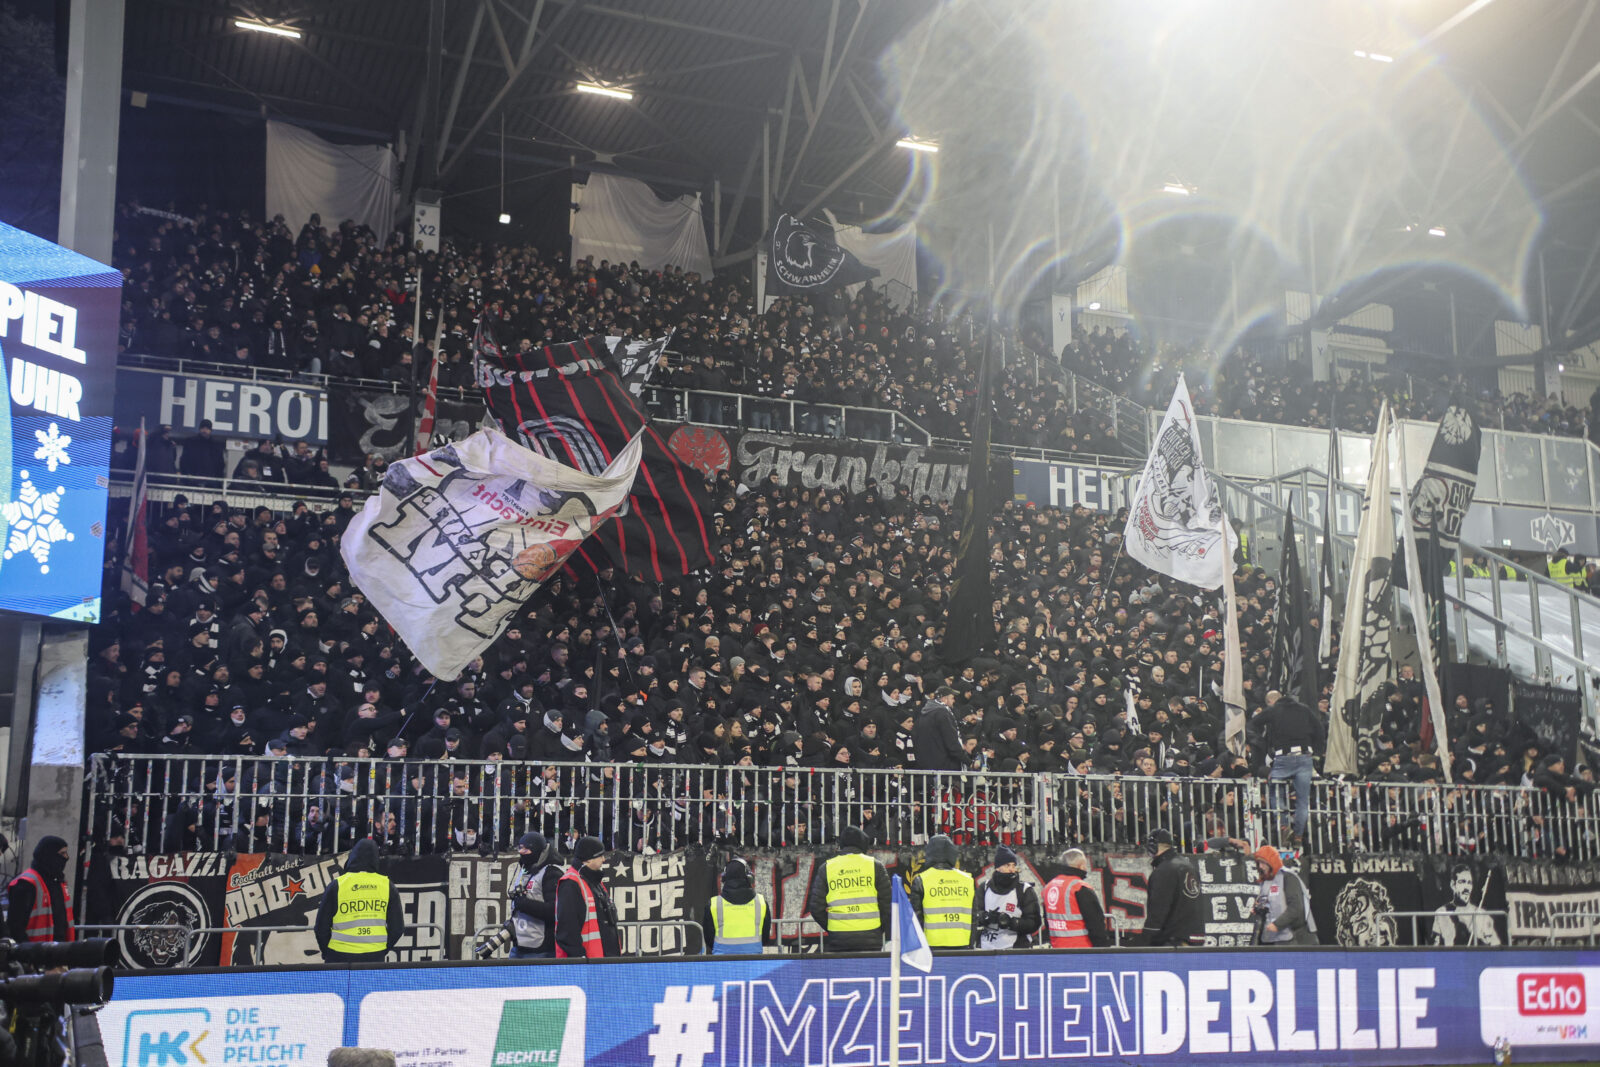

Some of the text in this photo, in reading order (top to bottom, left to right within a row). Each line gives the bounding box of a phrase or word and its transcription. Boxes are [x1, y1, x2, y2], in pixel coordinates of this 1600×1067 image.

[419, 224, 436, 236] X2
[10, 357, 83, 422] UHR
[737, 432, 969, 505] Frankfur
[1531, 513, 1576, 551] HAIX
[110, 852, 227, 880] RAGAZZI
[632, 855, 687, 883] DER
[1353, 857, 1415, 873] IMMER
[230, 865, 273, 888] Football
[829, 876, 873, 891] ORDNER
[609, 879, 686, 921] PPE
[929, 886, 969, 898] ORDNER
[339, 899, 387, 914] ORDNER
[398, 891, 447, 948] ED
[944, 913, 960, 922] 199
[1523, 977, 1582, 1010] Echo
[226, 1008, 260, 1025] DIE
[224, 1026, 281, 1043] HAFT
[1560, 1025, 1588, 1039] VRM
[223, 1044, 307, 1064] PFLICHT
[496, 1049, 558, 1065] BECHTLE
